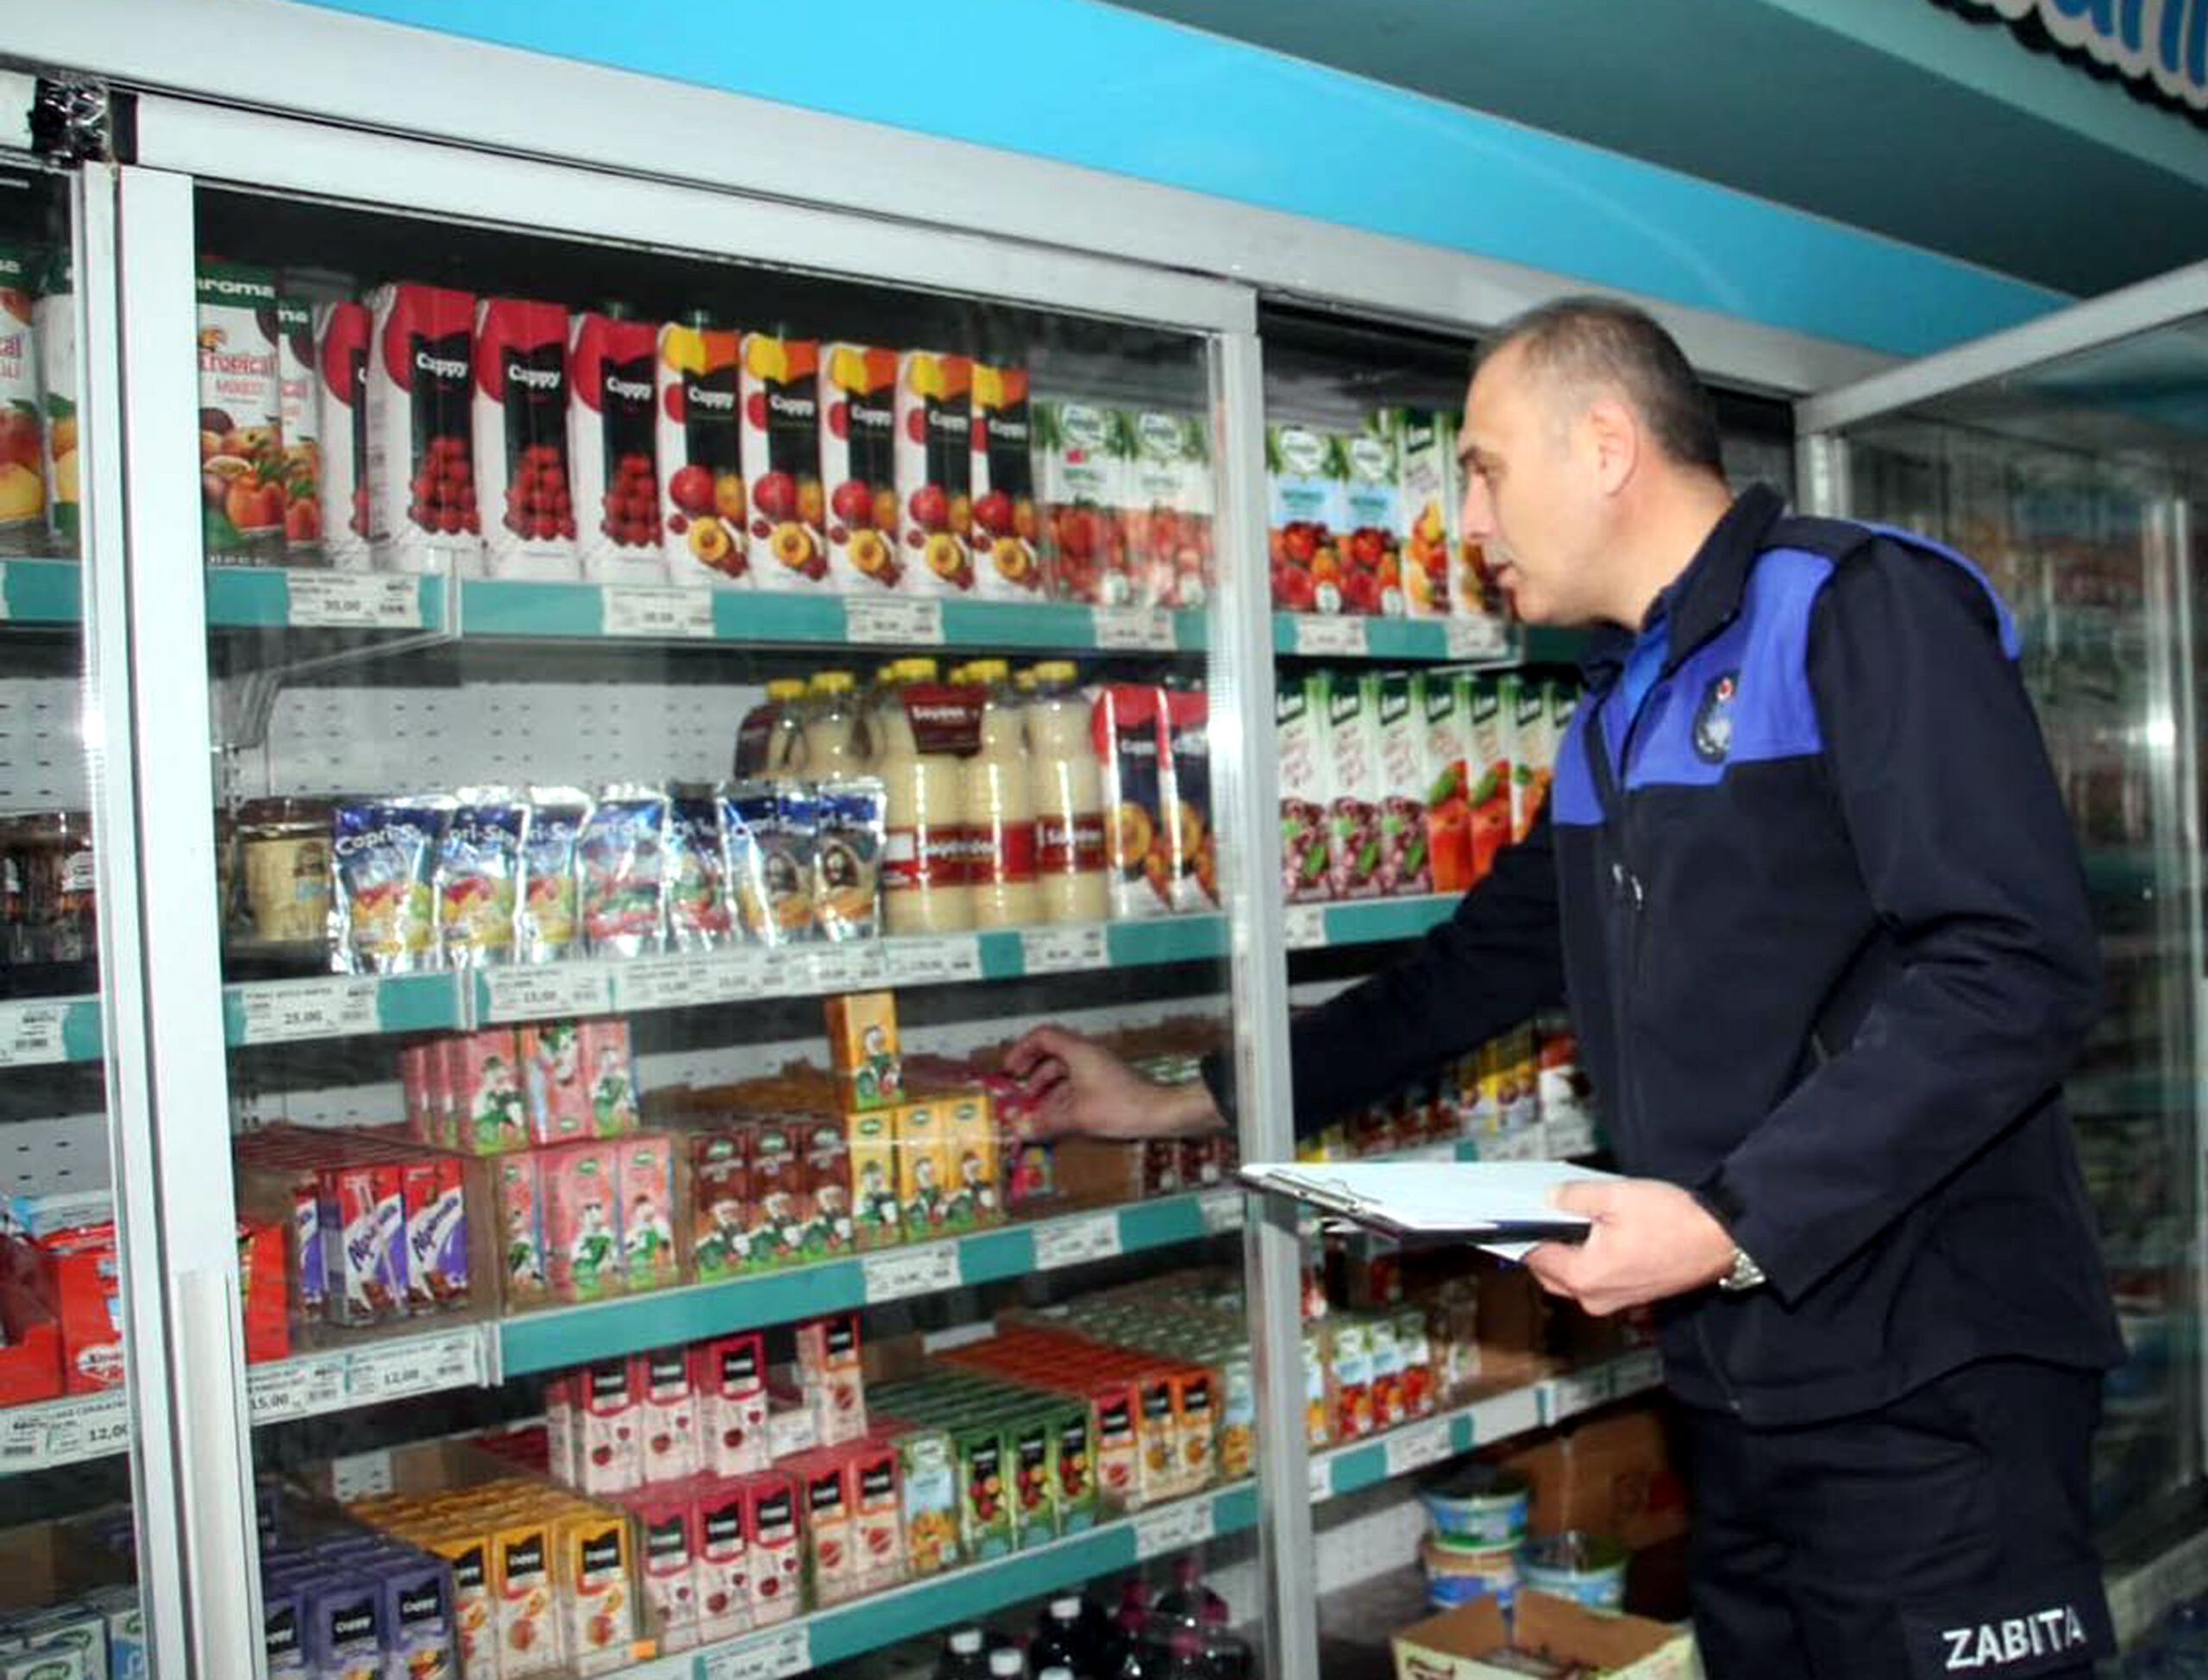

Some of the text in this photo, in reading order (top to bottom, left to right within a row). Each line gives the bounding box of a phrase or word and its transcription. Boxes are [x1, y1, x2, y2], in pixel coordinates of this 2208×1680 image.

[416, 352, 468, 379] Cappy
[508, 363, 561, 388] Cappy
[606, 376, 653, 400] Cappy
[688, 385, 735, 410] Cappy
[770, 394, 815, 417] Cappy
[1942, 1605, 2087, 1671] ZABITA
